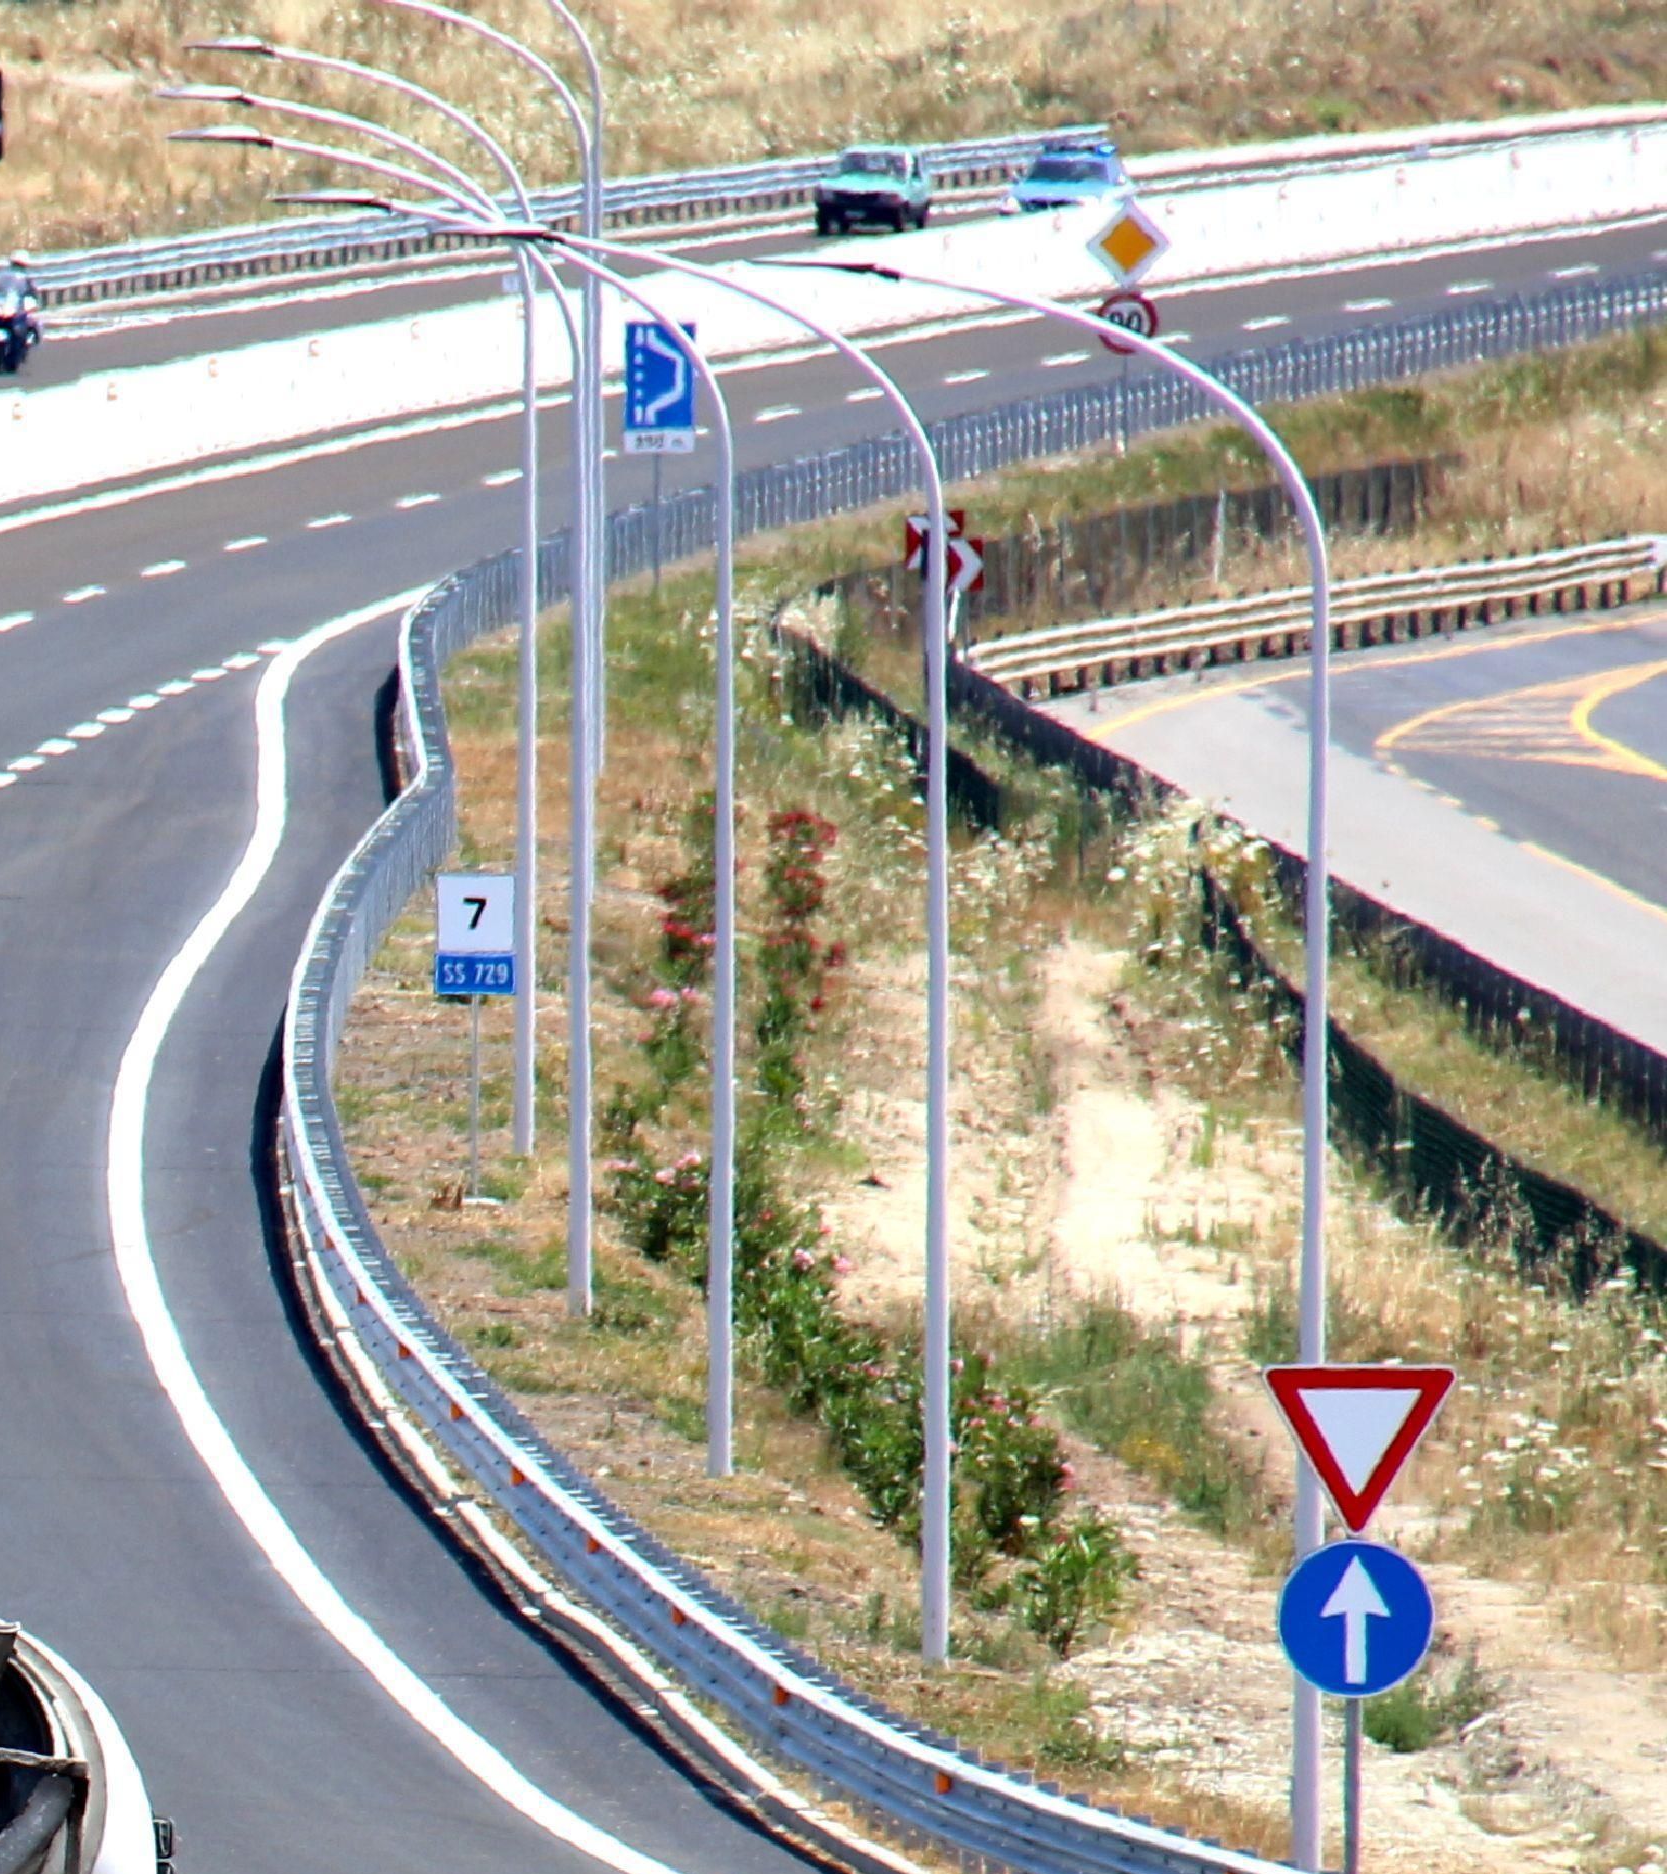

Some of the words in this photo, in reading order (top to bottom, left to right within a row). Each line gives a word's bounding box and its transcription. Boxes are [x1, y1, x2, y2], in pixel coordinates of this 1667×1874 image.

[463, 897, 487, 930] 7
[443, 963, 466, 984] SS
[473, 963, 510, 984] 729
